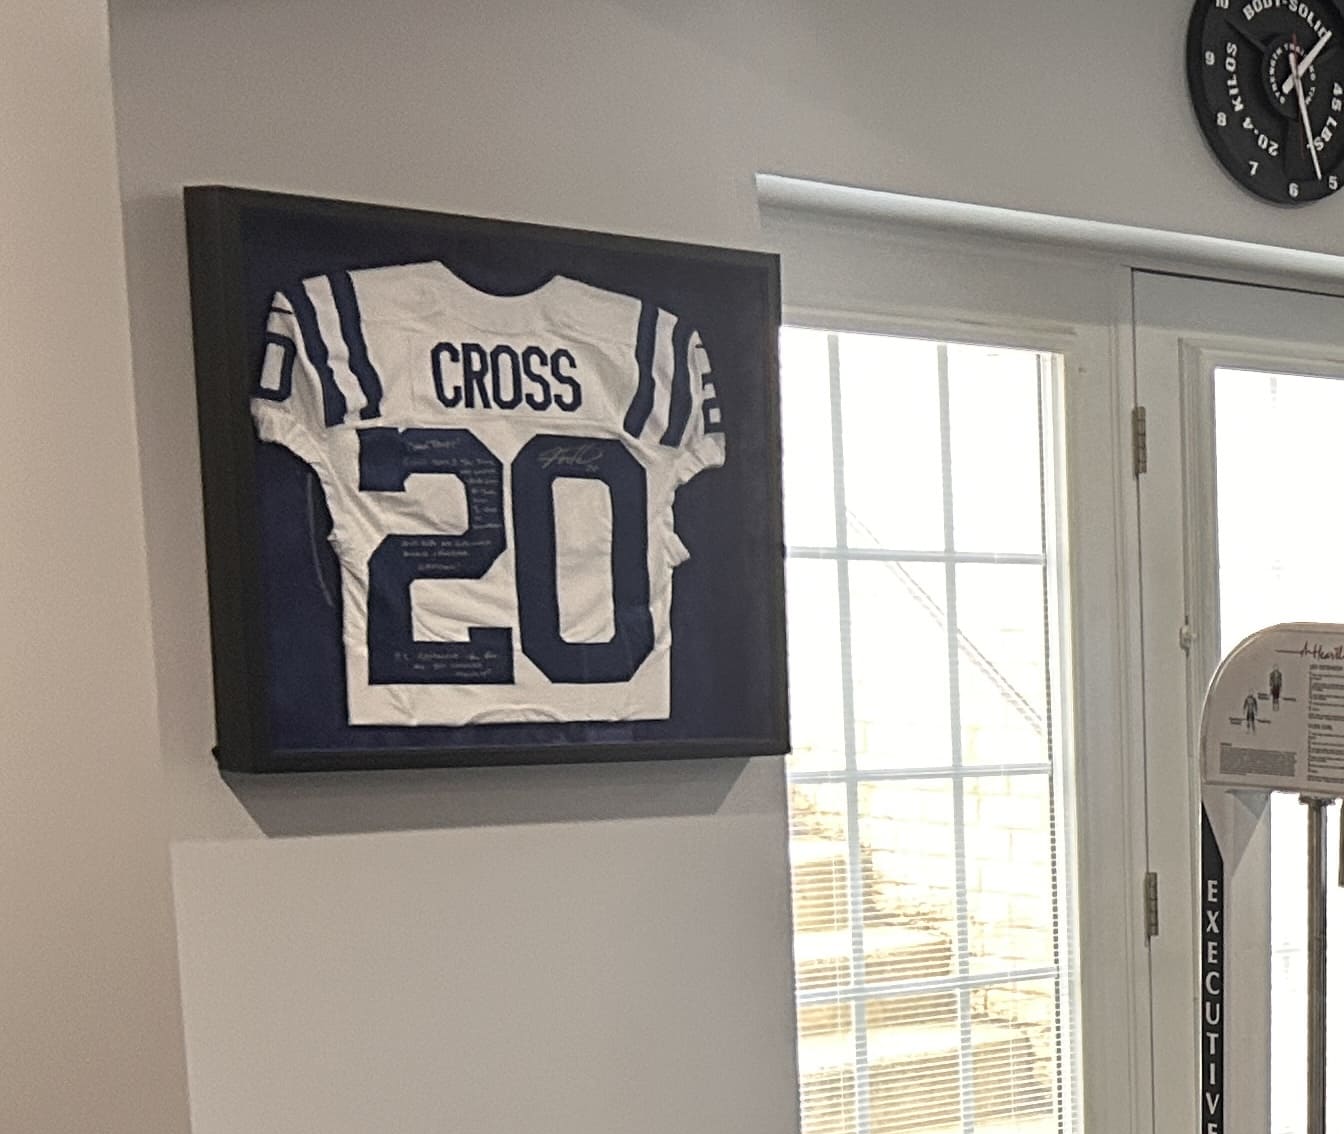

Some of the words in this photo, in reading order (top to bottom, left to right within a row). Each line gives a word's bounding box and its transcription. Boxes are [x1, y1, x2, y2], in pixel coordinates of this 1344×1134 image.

[1205, 51, 1215, 65] 9
[1225, 42, 1244, 112] KILOS
[1216, 112, 1227, 127] 8
[1249, 161, 1258, 176] 7
[1289, 183, 1299, 198] 6
[1329, 176, 1338, 190] 5
[430, 342, 582, 412] CROSS
[358, 428, 654, 686] 20
